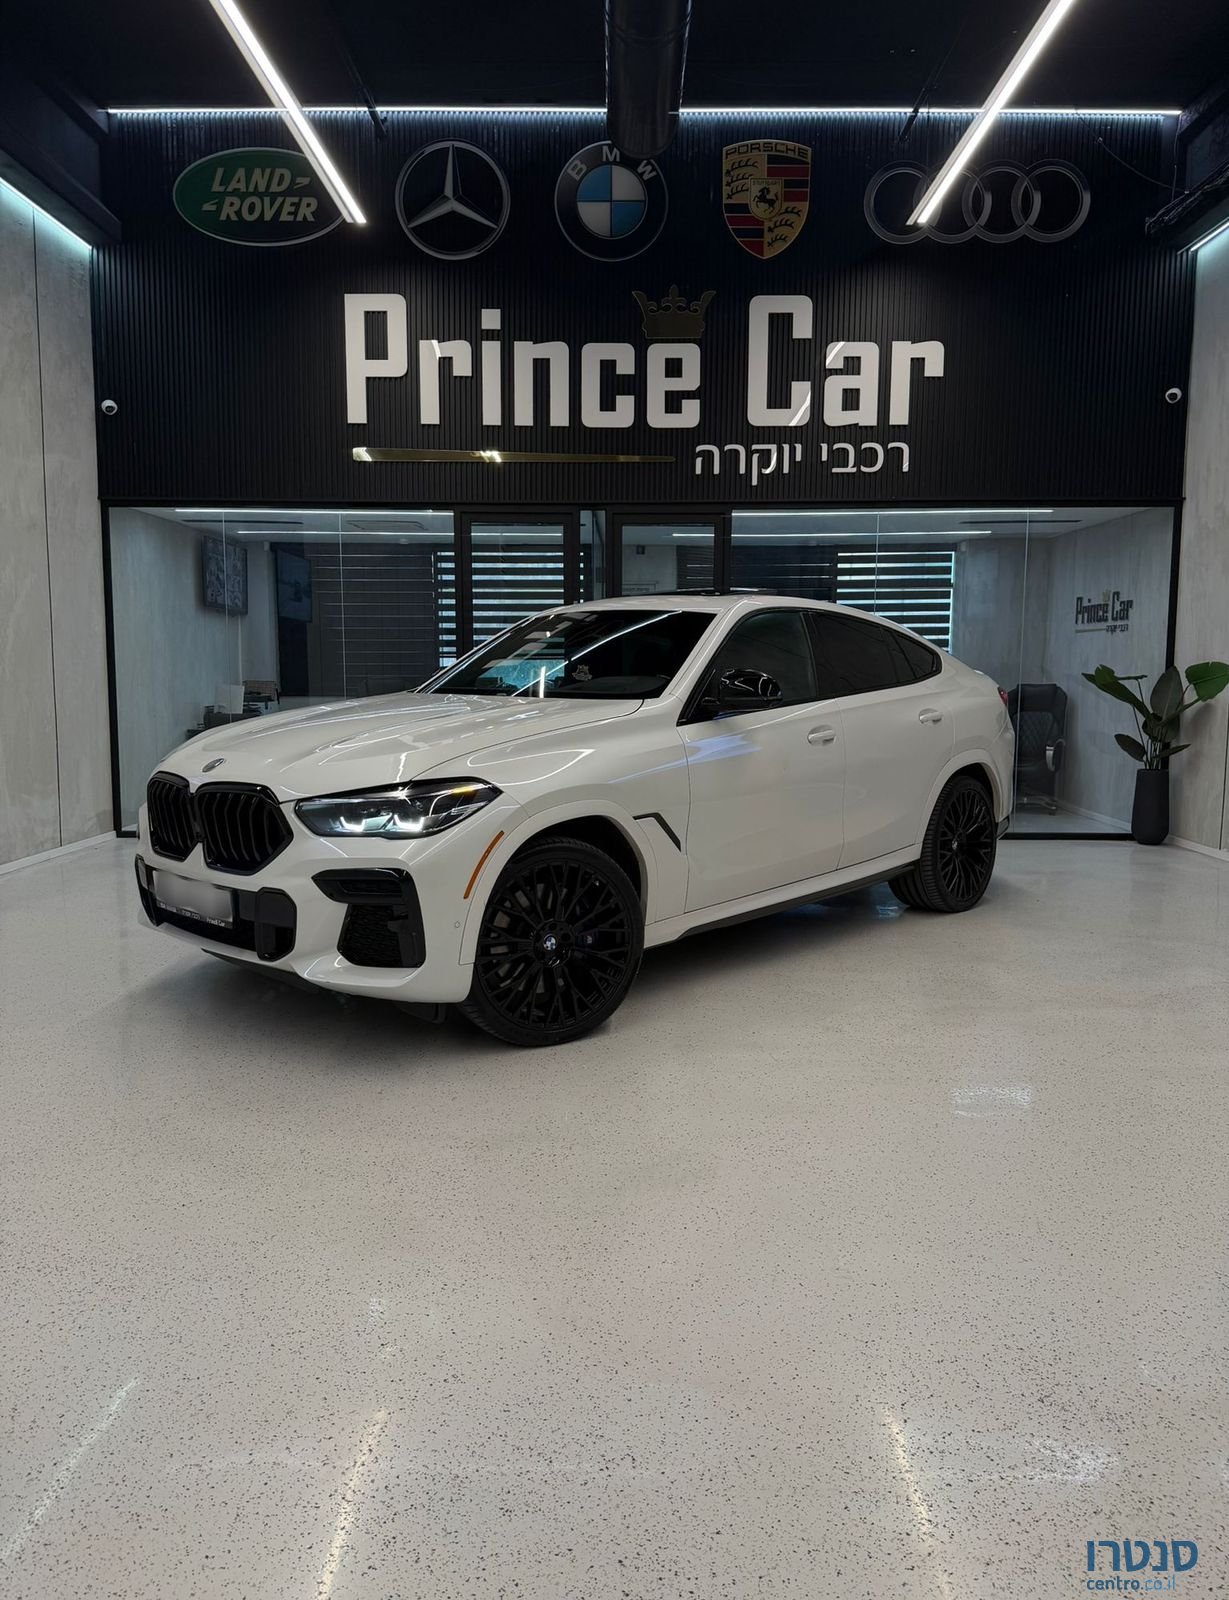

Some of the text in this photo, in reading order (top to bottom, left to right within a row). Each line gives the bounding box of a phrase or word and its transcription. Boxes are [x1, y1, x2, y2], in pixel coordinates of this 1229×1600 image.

[567, 145, 657, 181] BMW
[725, 142, 809, 159] PORSCHE
[212, 168, 291, 193] LAND
[221, 198, 318, 222] ROVER
[344, 293, 945, 429] Prince Car
[695, 441, 910, 486] רכבי יוקרה
[1075, 591, 1133, 624] Prince Car
